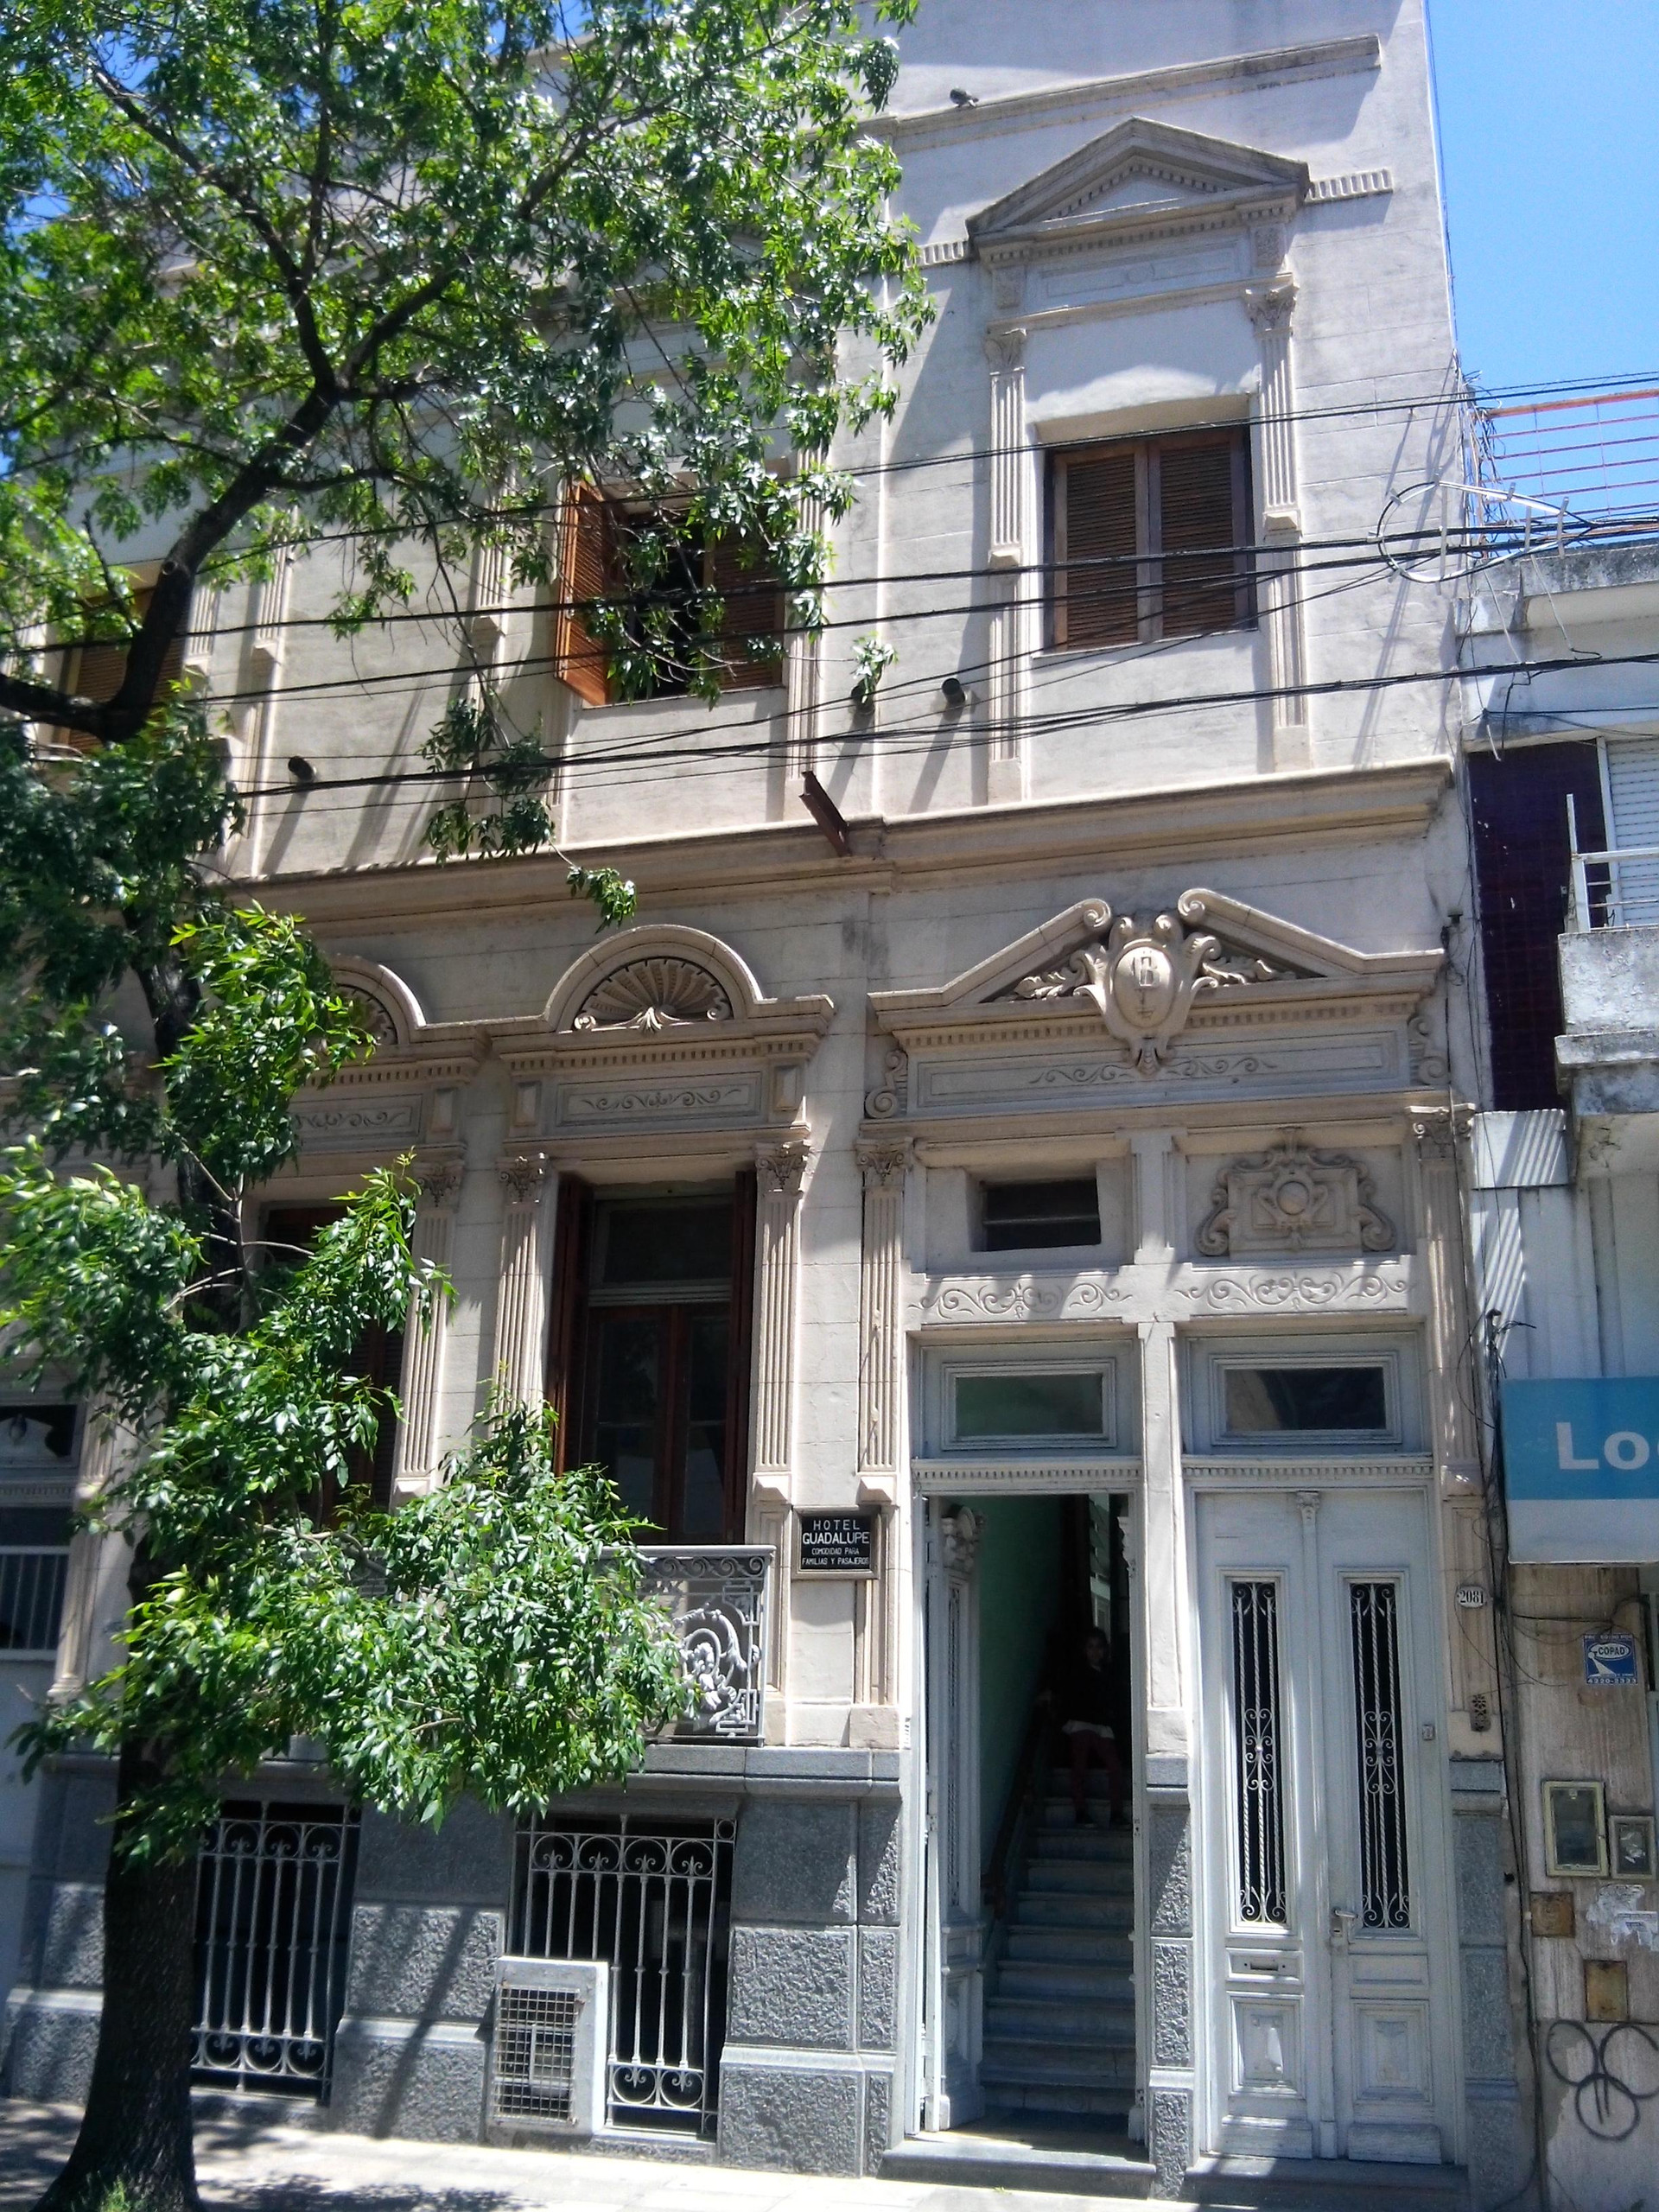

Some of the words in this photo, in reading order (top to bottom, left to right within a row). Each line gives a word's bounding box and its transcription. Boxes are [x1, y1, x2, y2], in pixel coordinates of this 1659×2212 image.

[813, 1520, 860, 1530] HOTEL
[802, 1532, 869, 1544] GUADALUPE
[1459, 1590, 1484, 1604] 2081
[1598, 1646, 1625, 1655] COPAD
